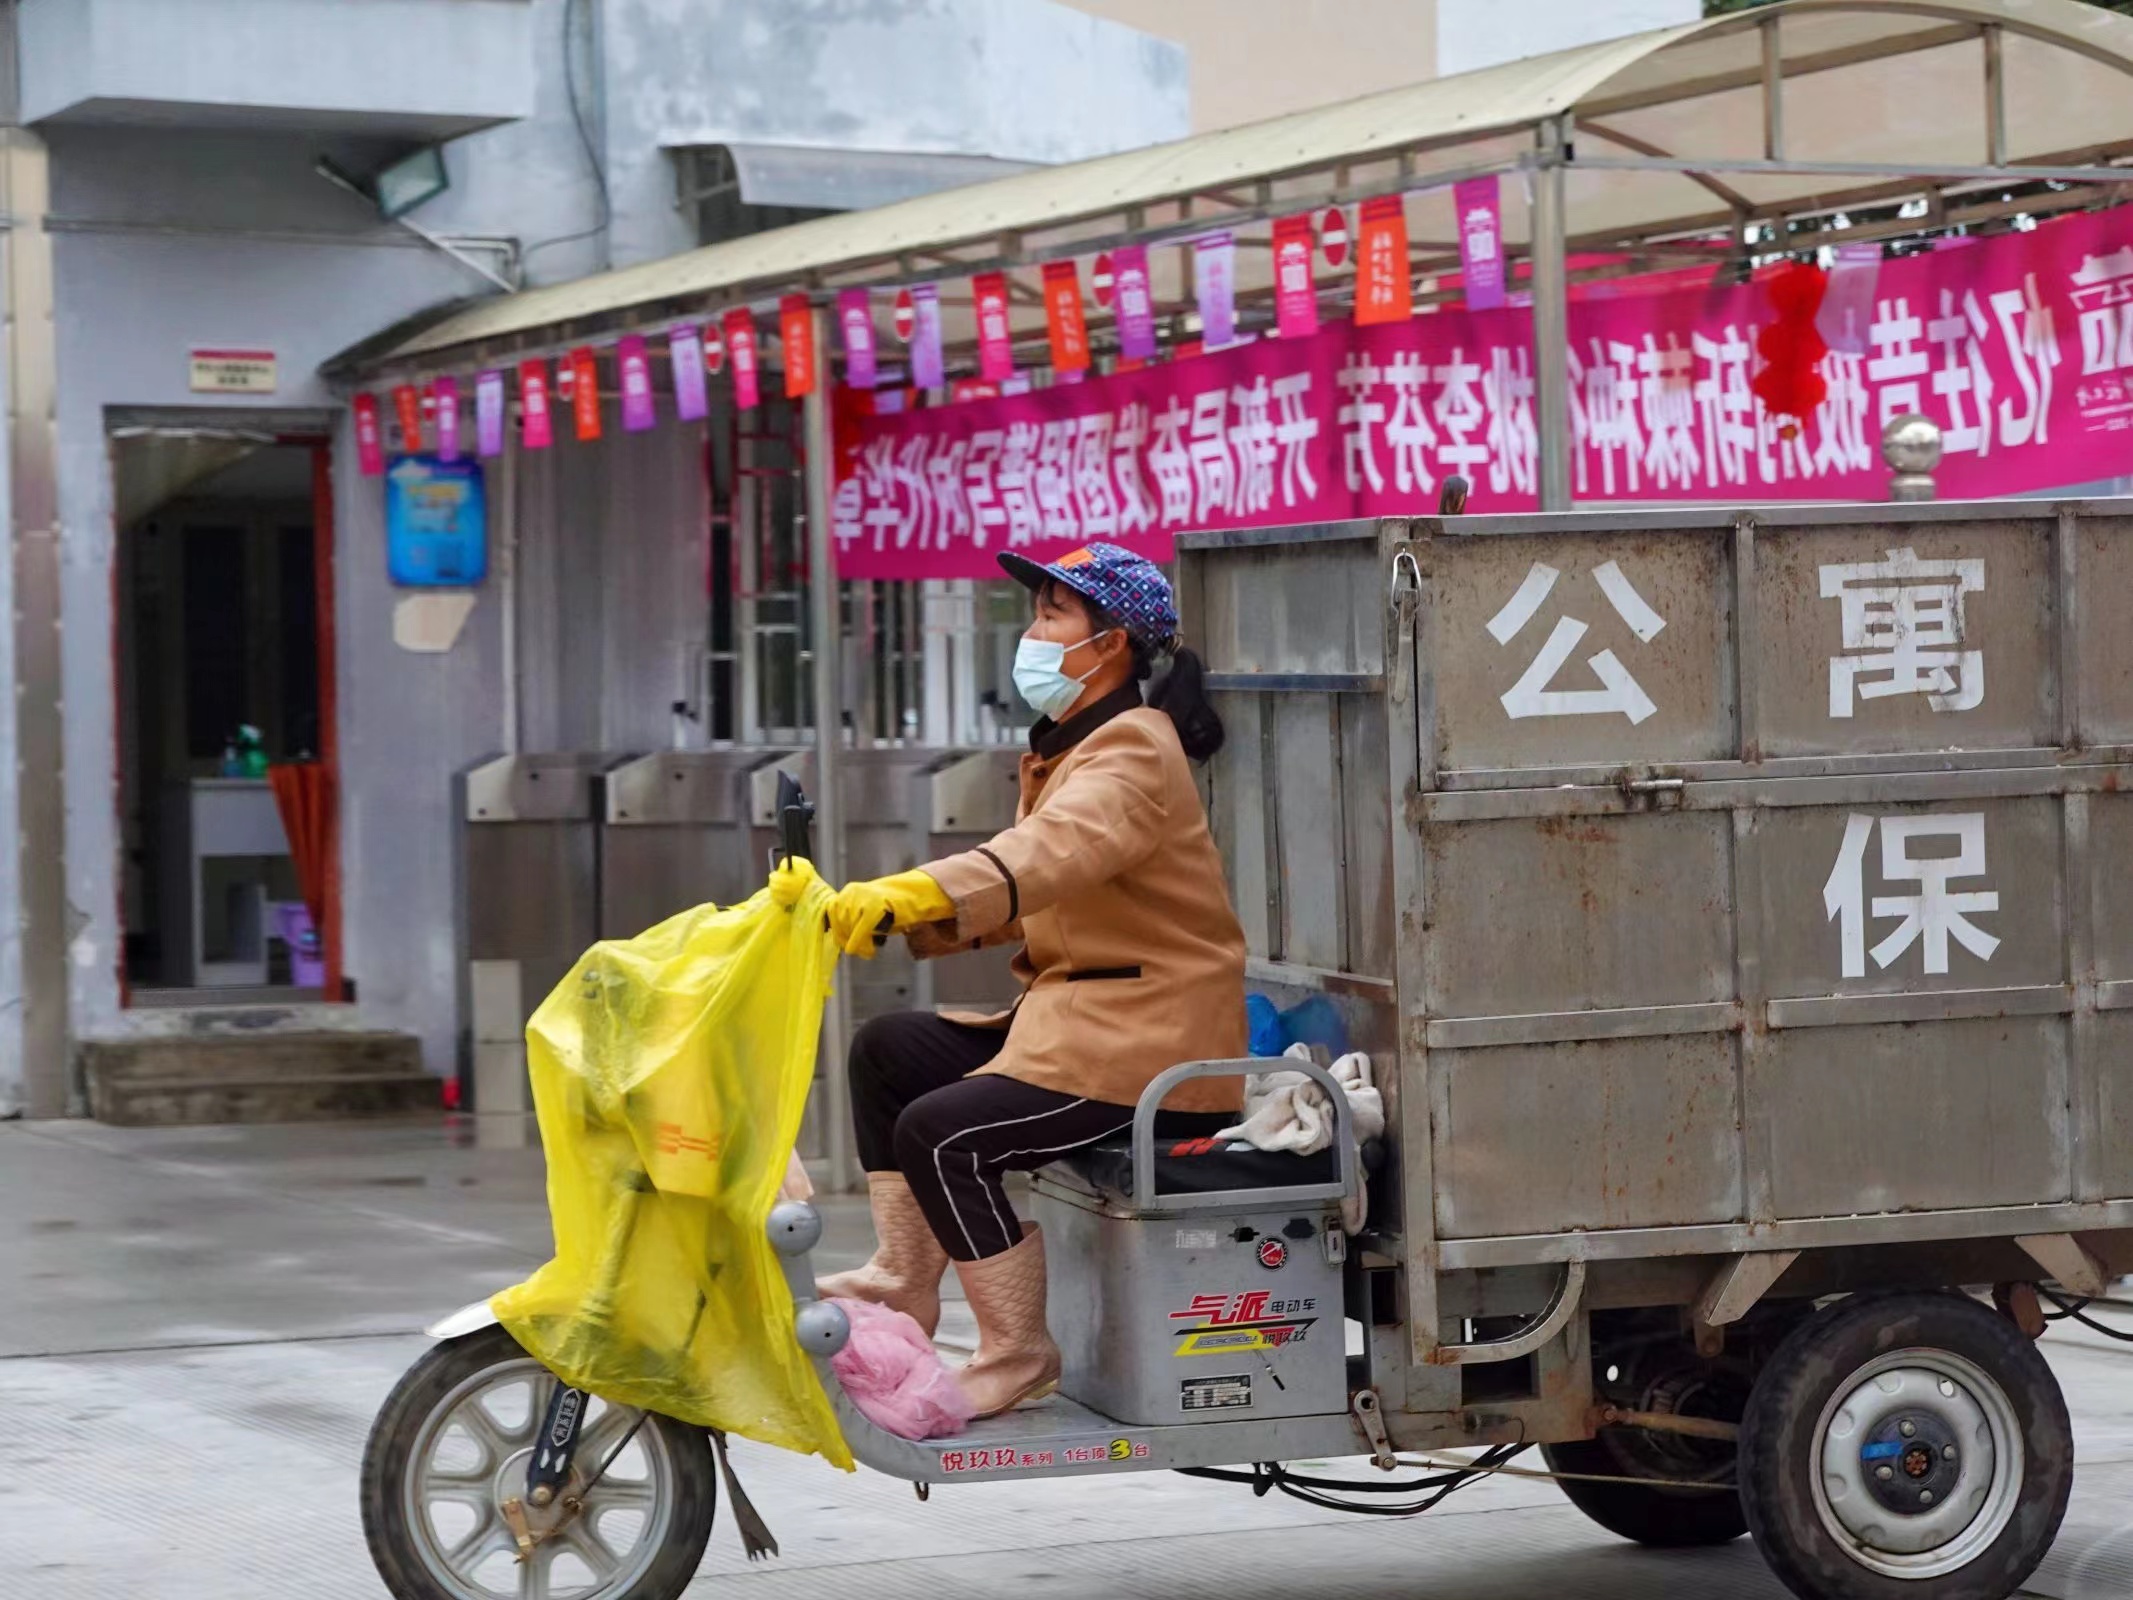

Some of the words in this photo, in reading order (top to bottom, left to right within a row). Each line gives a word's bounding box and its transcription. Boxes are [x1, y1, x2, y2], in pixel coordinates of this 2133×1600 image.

[1823, 812, 2001, 977] 保
[1168, 1290, 1285, 1325] 气派
[1271, 1298, 1316, 1313] 电动车
